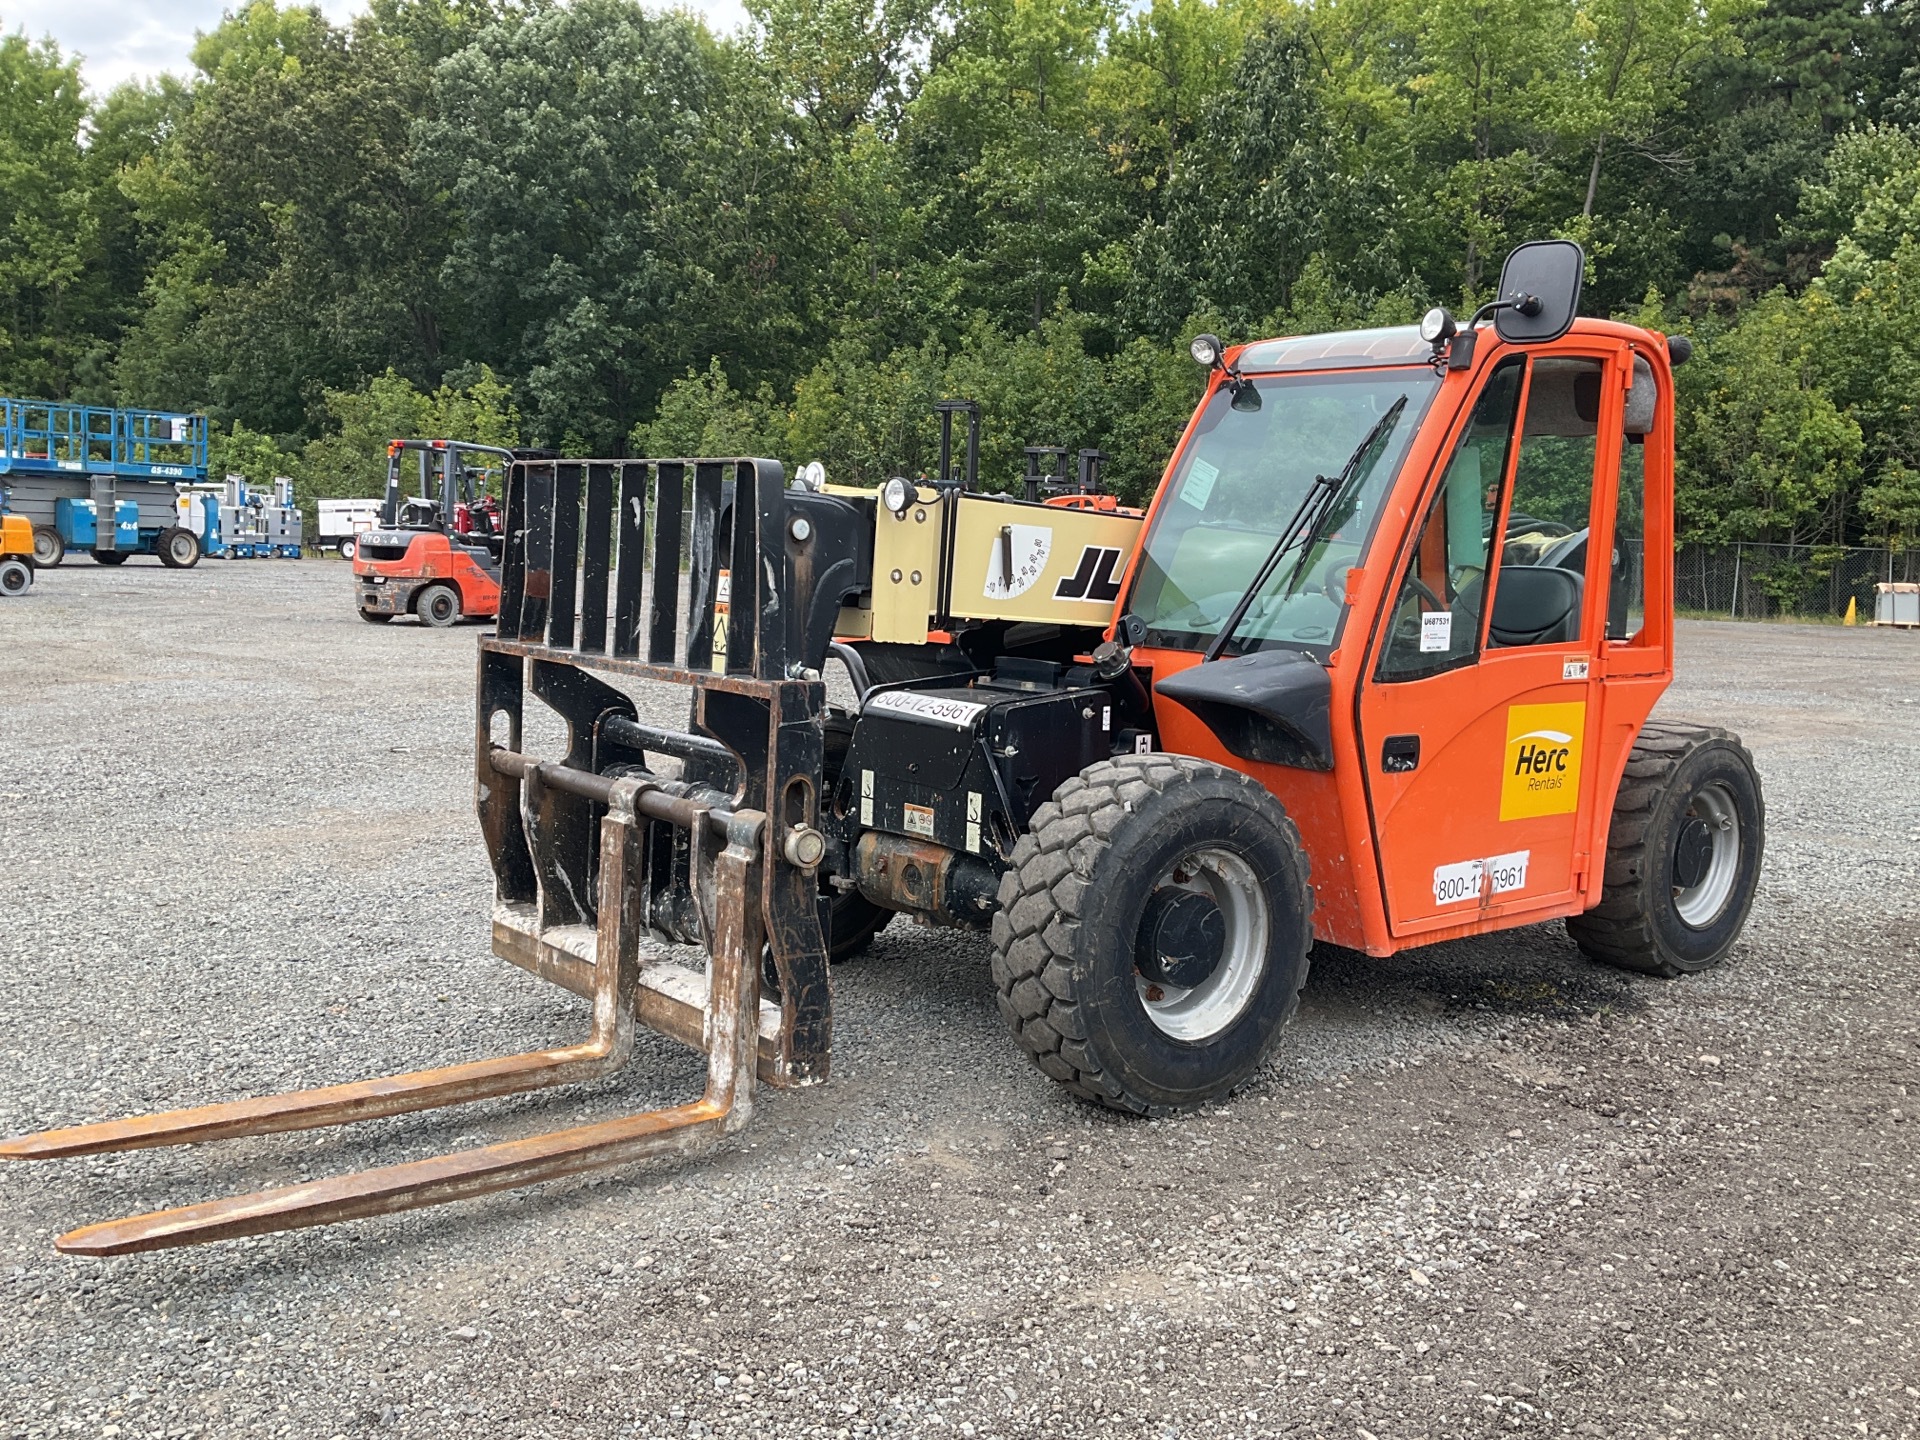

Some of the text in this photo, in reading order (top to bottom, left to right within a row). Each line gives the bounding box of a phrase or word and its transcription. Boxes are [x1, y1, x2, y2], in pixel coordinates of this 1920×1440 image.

[151, 466, 182, 475] GS-4390
[121, 521, 137, 531] 4x4
[1034, 539, 1043, 547] 80
[1036, 549, 1045, 558] 70
[1053, 545, 1126, 603] JL
[1016, 576, 1025, 588] 30
[1424, 617, 1450, 626] U687531
[877, 692, 977, 722] 800-12-5961
[1514, 744, 1569, 776] Herc
[1527, 775, 1563, 792] Rentals
[1438, 865, 1524, 901] 800-15961
